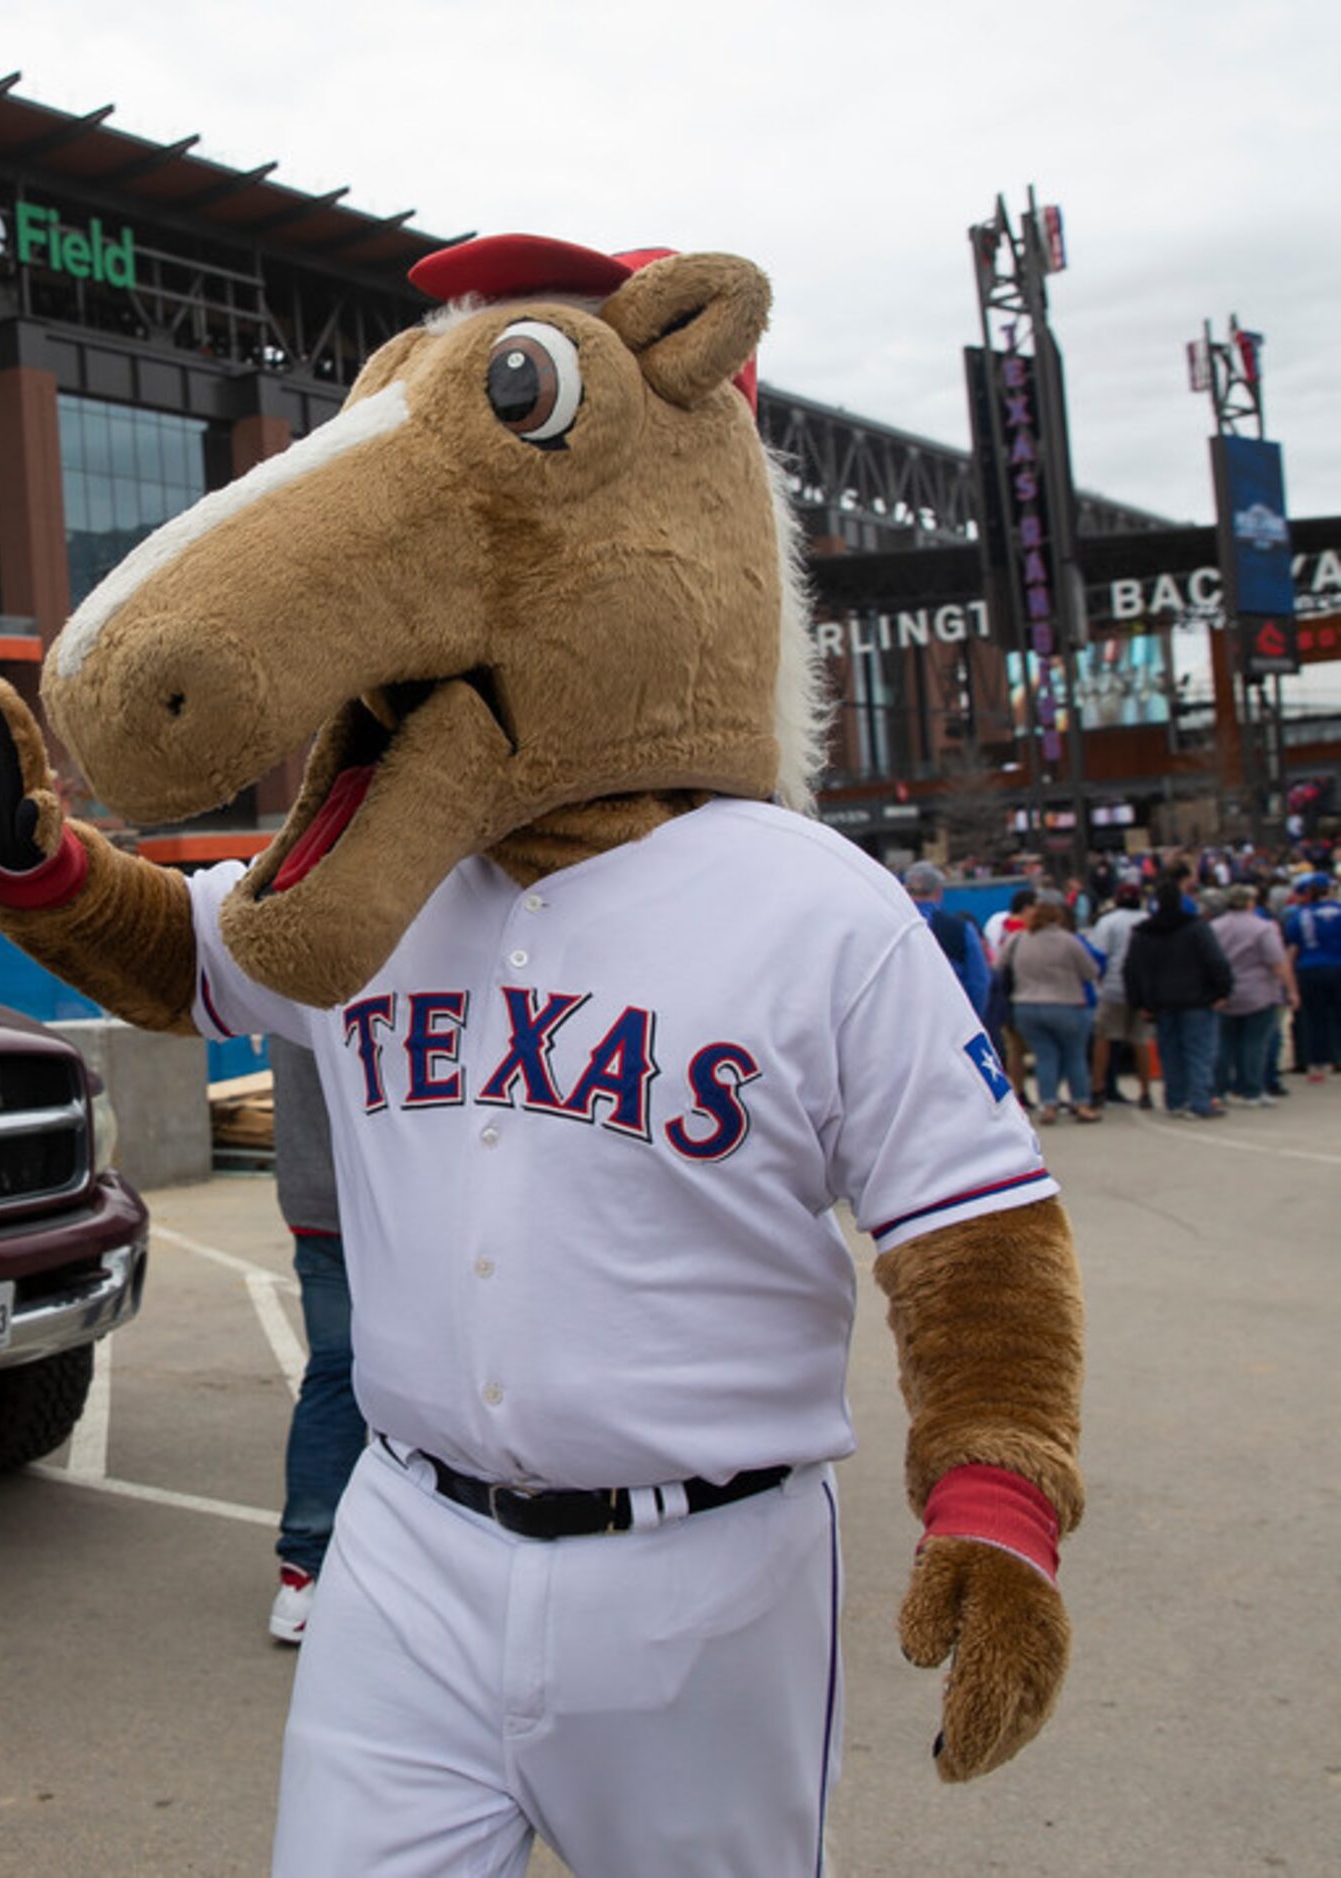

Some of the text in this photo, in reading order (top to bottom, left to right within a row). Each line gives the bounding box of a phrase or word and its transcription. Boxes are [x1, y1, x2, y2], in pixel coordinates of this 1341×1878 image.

[15, 201, 136, 290] Field
[1000, 322, 1039, 502] TEXAS
[343, 986, 762, 1164] TEXAS
